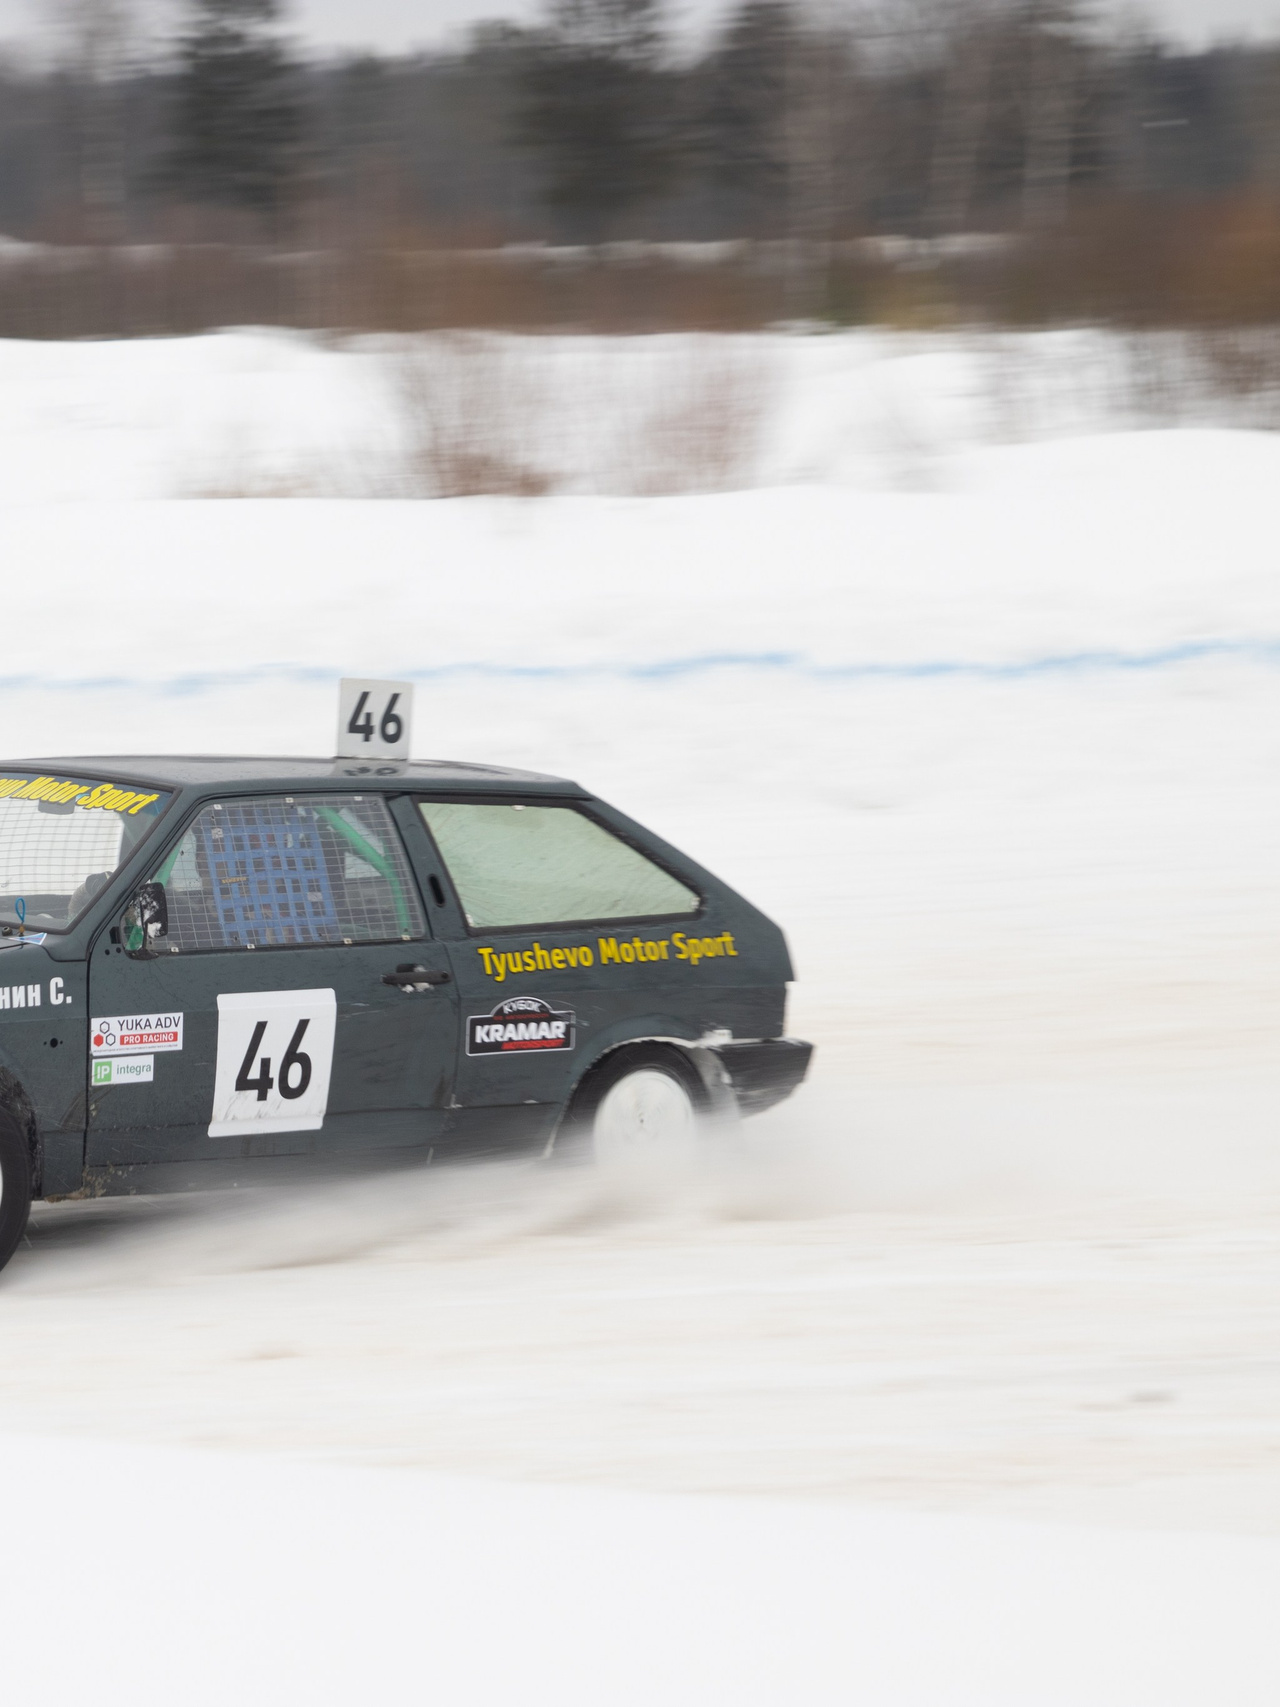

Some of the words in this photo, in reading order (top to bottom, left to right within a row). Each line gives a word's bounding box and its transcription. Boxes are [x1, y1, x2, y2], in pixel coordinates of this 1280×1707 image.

[347, 691, 403, 743] 46
[9, 776, 91, 805] Motor
[75, 783, 159, 815] Sport
[477, 942, 594, 982] Tyushevo
[597, 937, 670, 965] Motor
[671, 931, 738, 965] Sport
[117, 1018, 152, 1032] YUKA
[154, 1015, 181, 1029] ADV
[123, 1035, 140, 1044] PRO
[142, 1032, 174, 1043] RACING
[475, 1021, 566, 1043] KRAMAR
[116, 1063, 151, 1077] integra
[235, 1018, 312, 1102] 46
